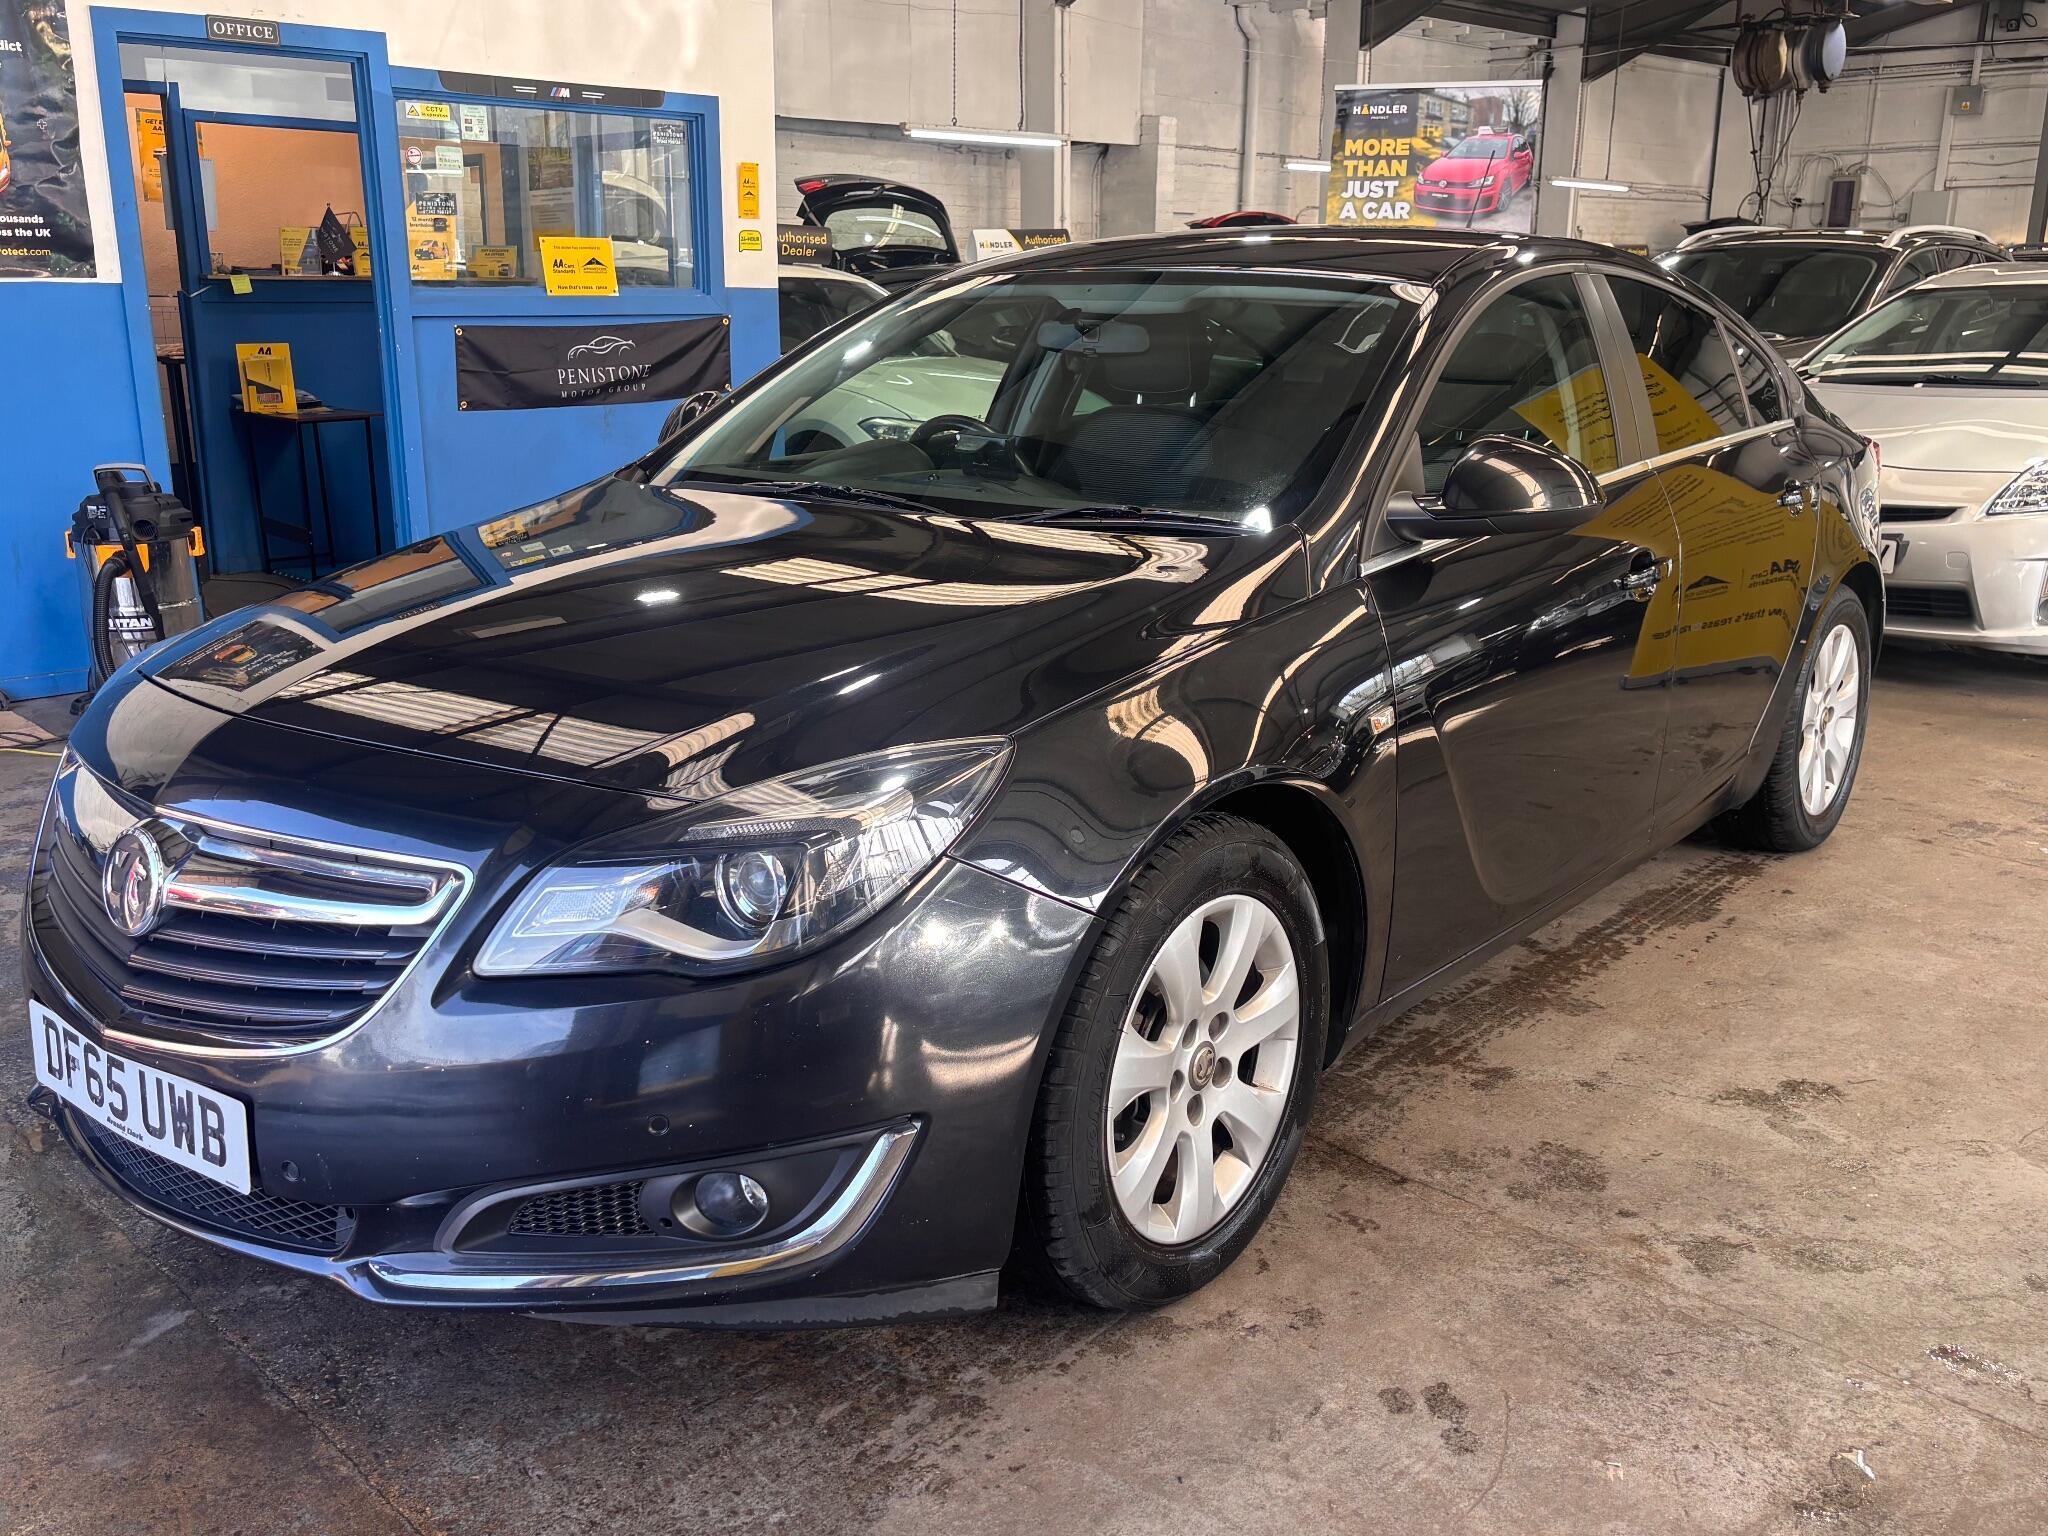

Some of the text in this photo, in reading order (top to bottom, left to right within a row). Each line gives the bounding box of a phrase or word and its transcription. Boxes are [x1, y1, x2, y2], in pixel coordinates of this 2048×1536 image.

[213, 22, 274, 39] OFFICE
[1344, 138, 1412, 156] MORE
[1344, 160, 1408, 177] THAN
[1341, 180, 1399, 199] JUST
[1339, 202, 1411, 220] A CAR
[15, 228, 32, 236] the
[35, 228, 51, 237] UK
[777, 230, 827, 244] uthorised
[1024, 234, 1067, 244] Authorised
[782, 244, 816, 256] Dealer
[553, 259, 564, 268] AA
[258, 347, 272, 355] AA
[558, 364, 652, 385] PENISTONE
[561, 383, 646, 398] MOTOR GROUP
[42, 1015, 226, 1167] DF65 UWB
